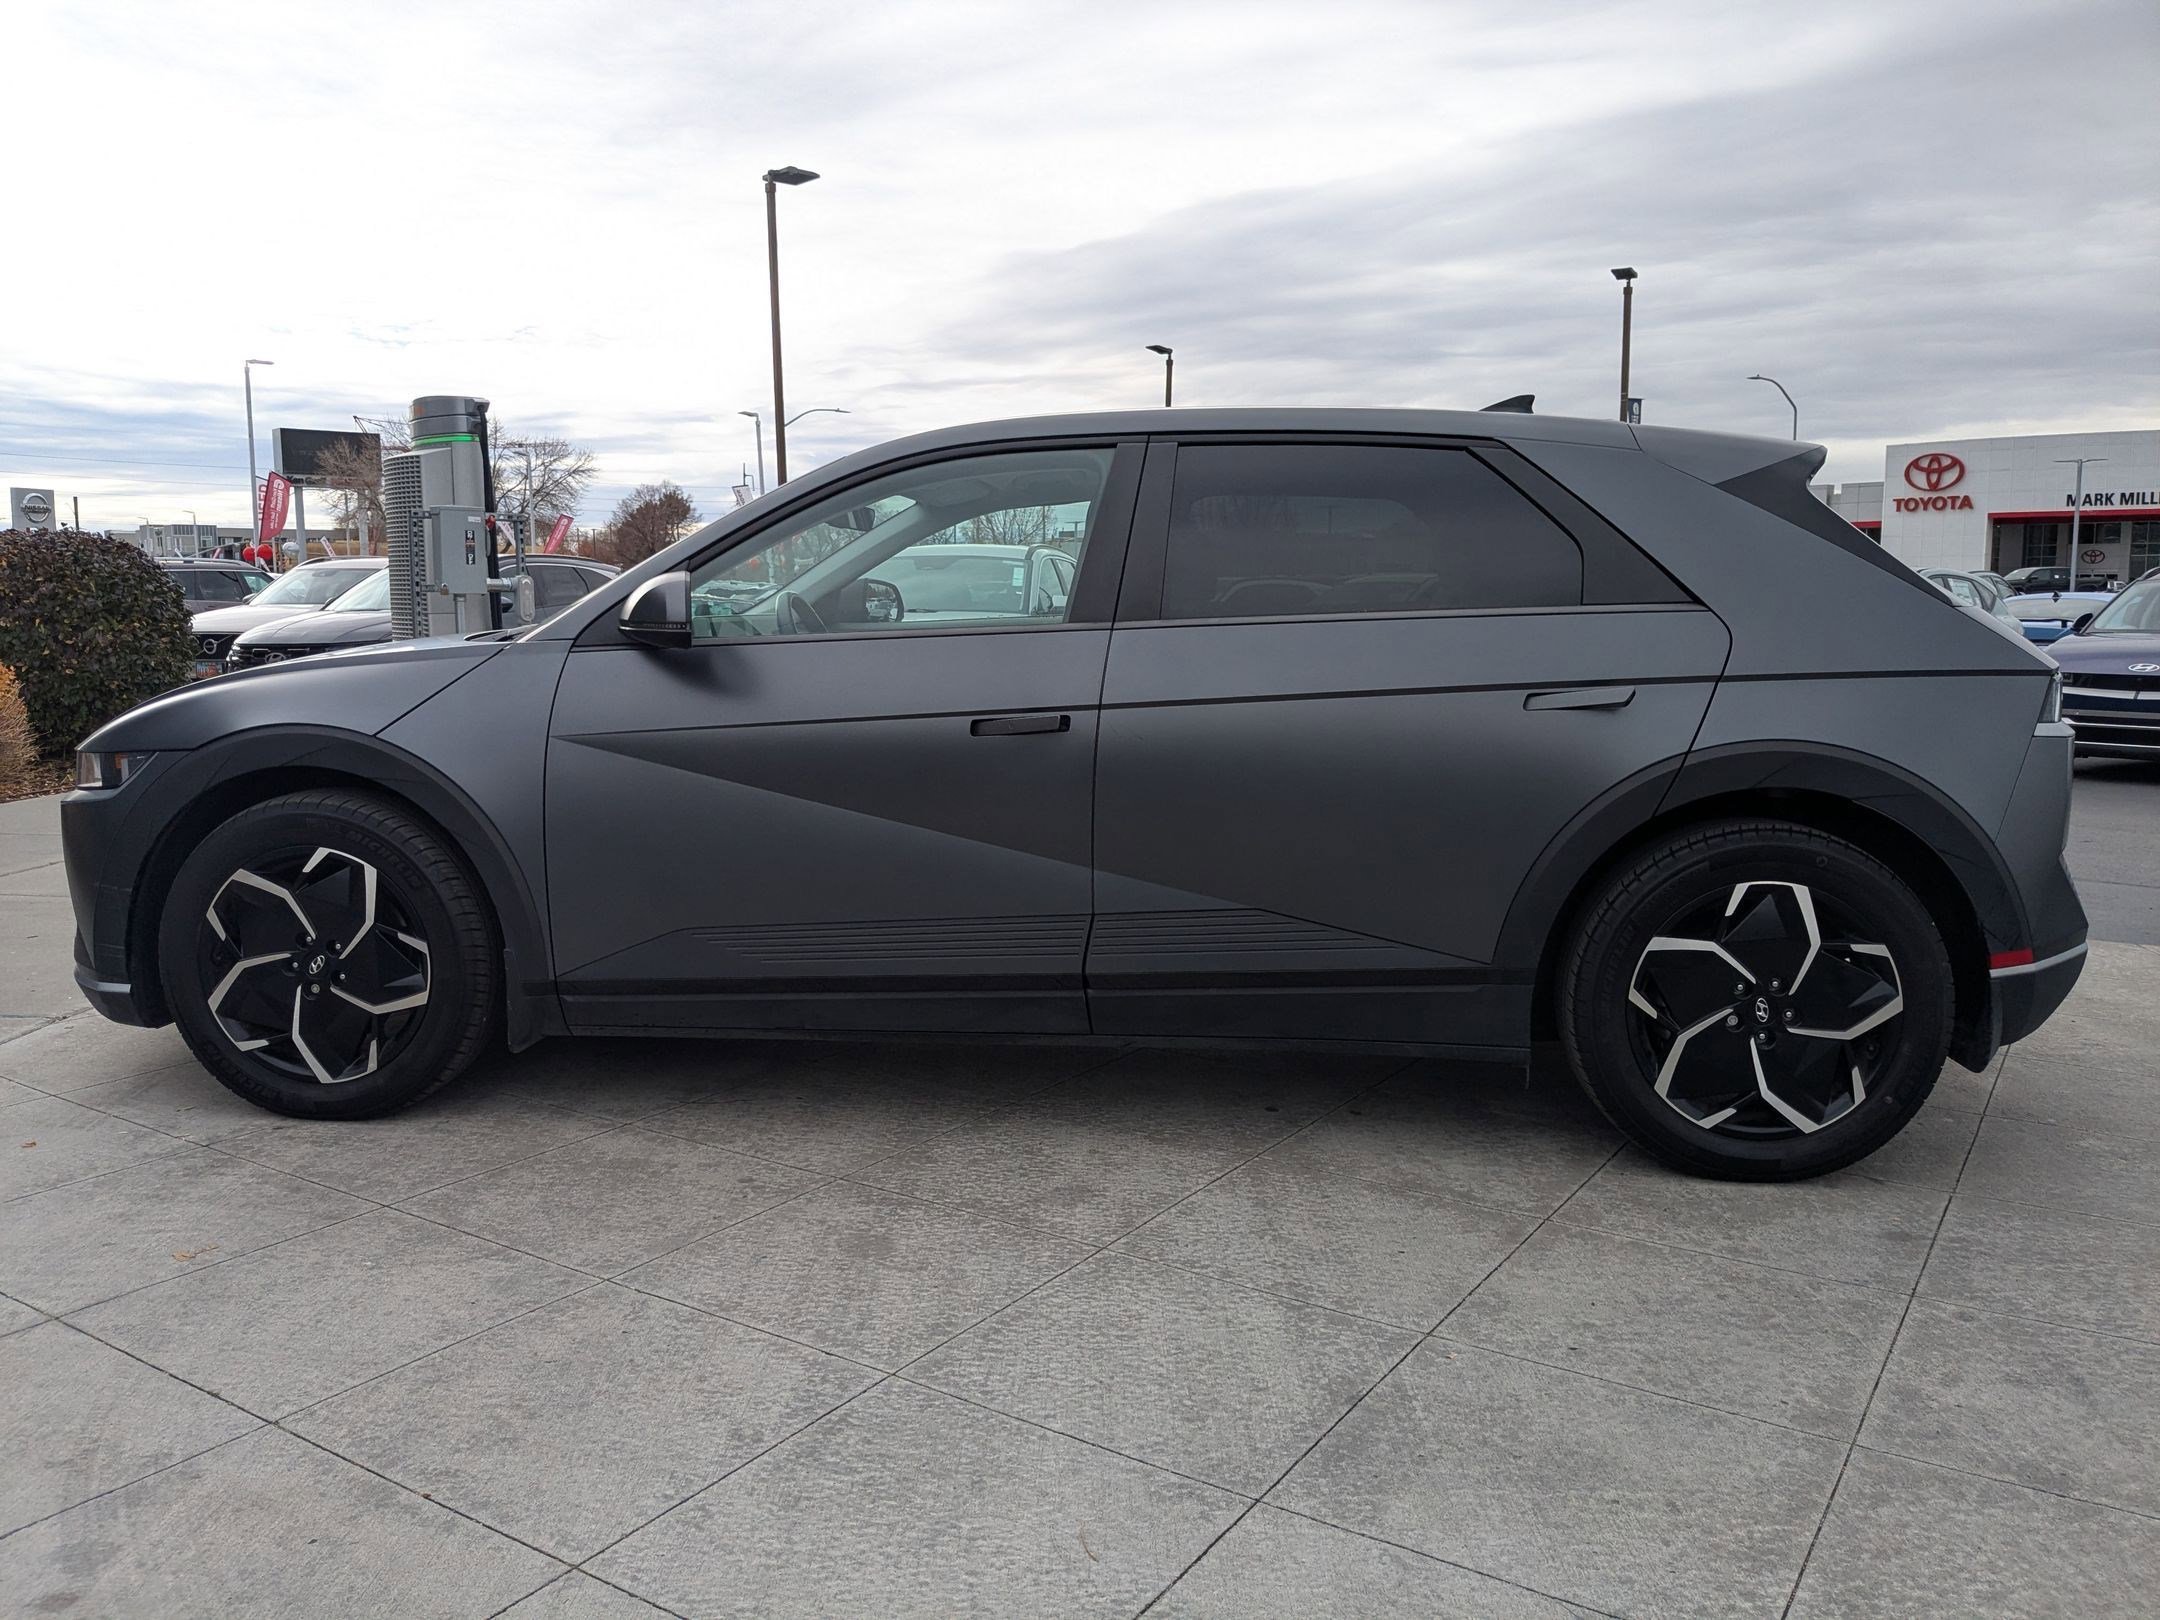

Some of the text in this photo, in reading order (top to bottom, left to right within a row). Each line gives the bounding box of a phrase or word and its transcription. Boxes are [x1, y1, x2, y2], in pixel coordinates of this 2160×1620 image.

[1893, 495, 1974, 512] TOYOTA
[2066, 491, 2160, 507] MARK MILL
